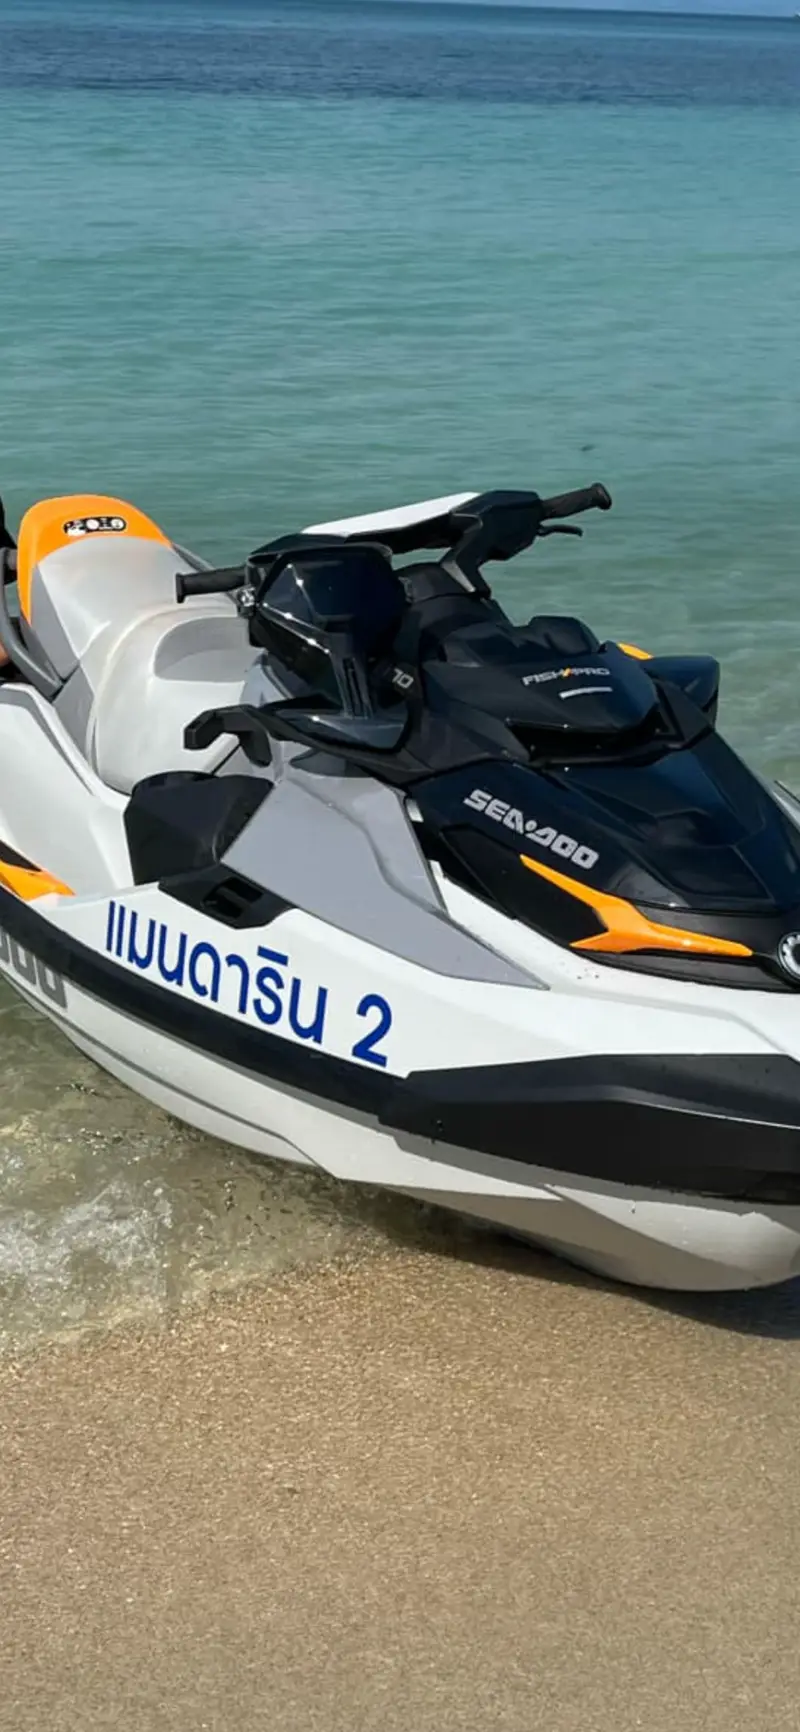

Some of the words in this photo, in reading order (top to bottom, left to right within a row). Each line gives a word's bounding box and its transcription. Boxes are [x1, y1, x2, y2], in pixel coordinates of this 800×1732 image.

[106, 900, 328, 1045] แมนดาริน
[352, 994, 392, 1067] 2
